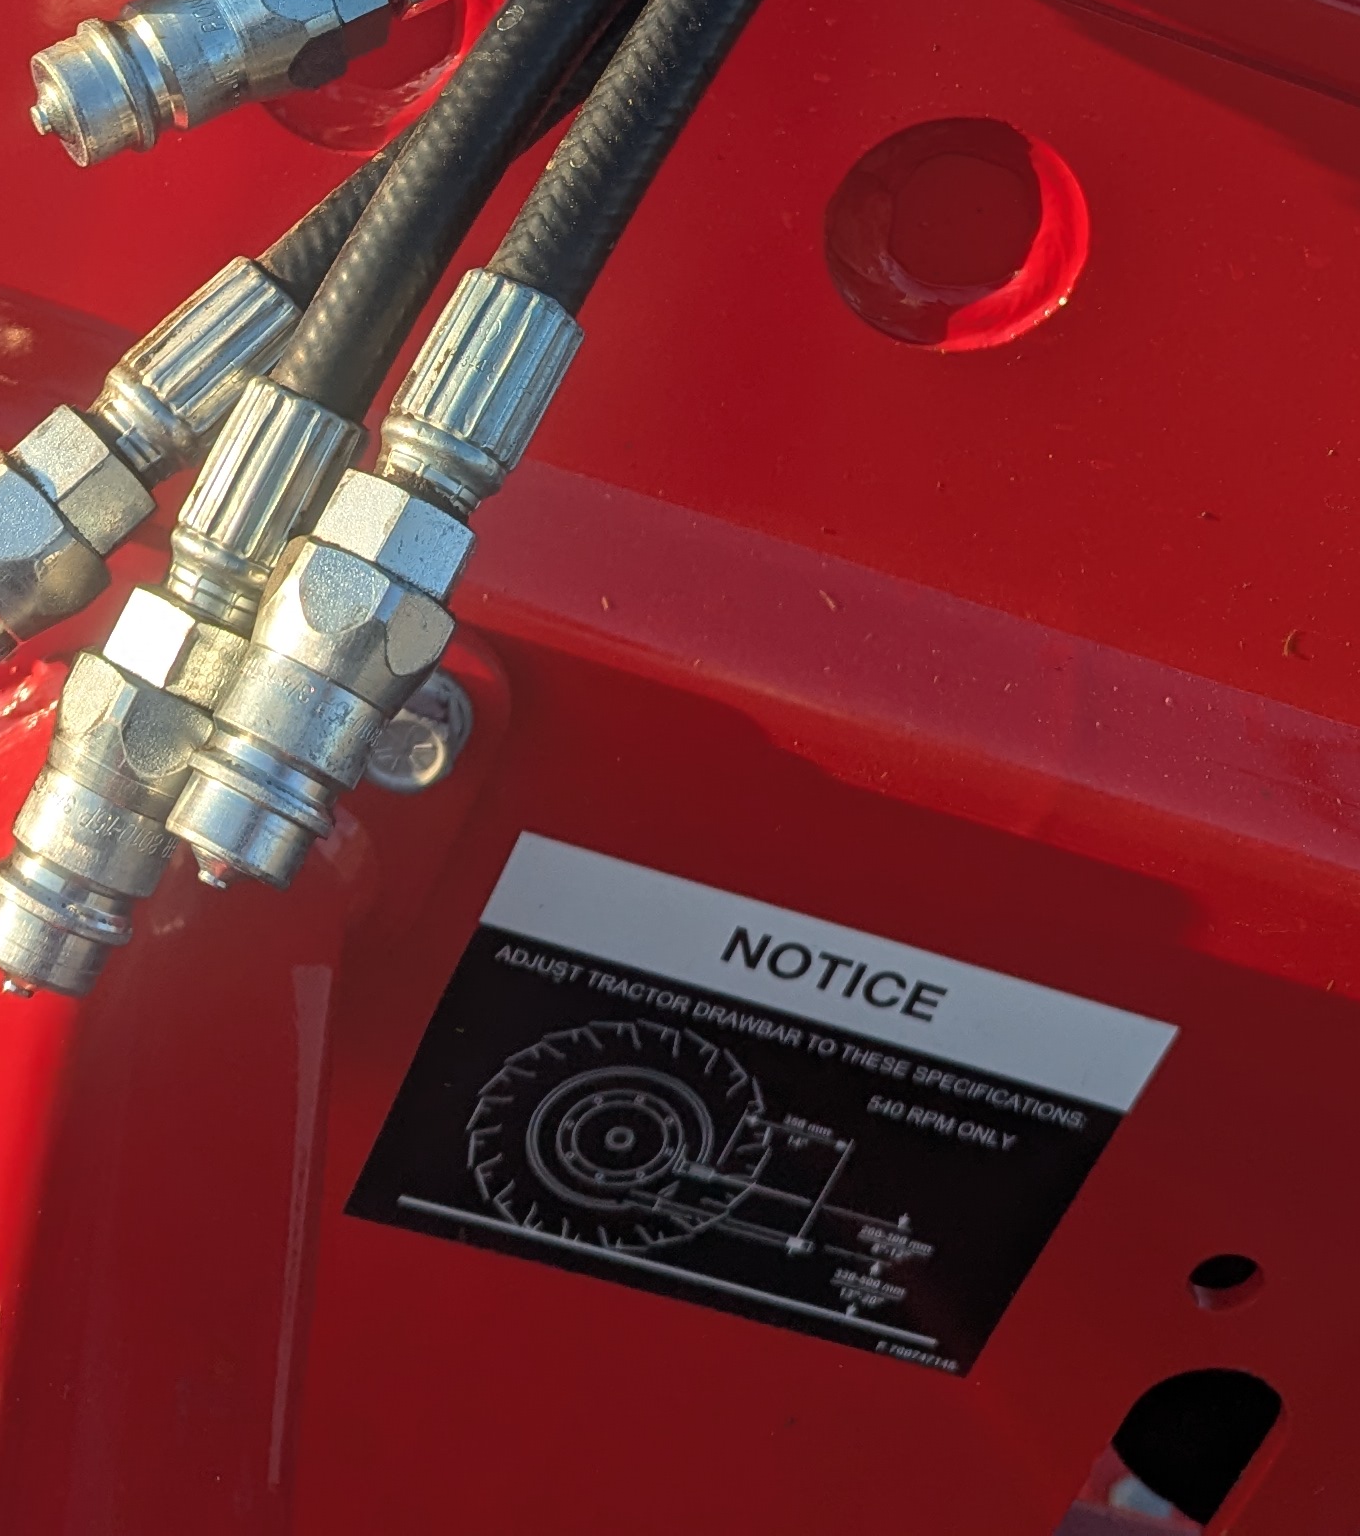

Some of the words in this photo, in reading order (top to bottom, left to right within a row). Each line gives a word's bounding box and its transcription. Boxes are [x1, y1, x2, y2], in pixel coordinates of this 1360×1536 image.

[720, 926, 947, 1022] NOTICE
[494, 945, 583, 985] ADJUST
[587, 970, 691, 1013] TRACTOR
[692, 999, 802, 1049] DRAWBAR
[806, 1033, 839, 1059] TO
[840, 1043, 911, 1080] THESE
[912, 1063, 1089, 1131] SPECIFICATIONS:
[905, 1104, 959, 1135] RPM
[957, 1116, 1018, 1152] ONLY
